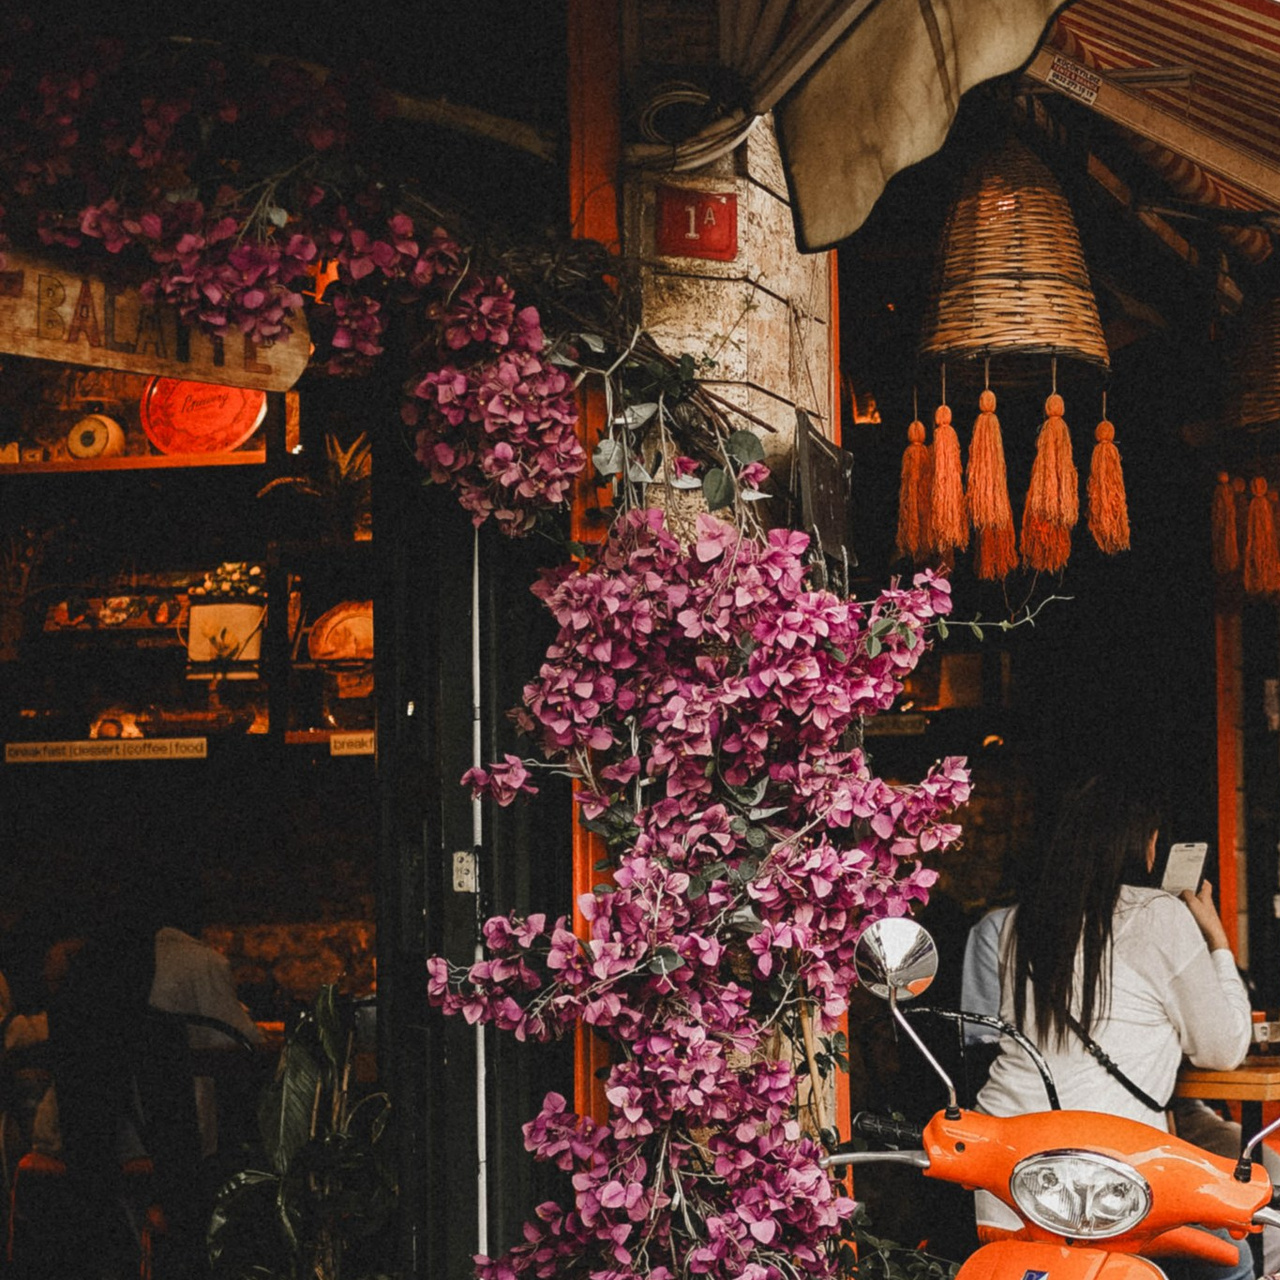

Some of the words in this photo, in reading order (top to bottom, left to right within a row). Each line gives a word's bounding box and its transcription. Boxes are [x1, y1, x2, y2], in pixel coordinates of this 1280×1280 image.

[7, 744, 67, 759] breakfast
[72, 743, 120, 756] dessert
[126, 742, 169, 756] coffee
[174, 740, 205, 754] food
[334, 738, 375, 751] breakf
